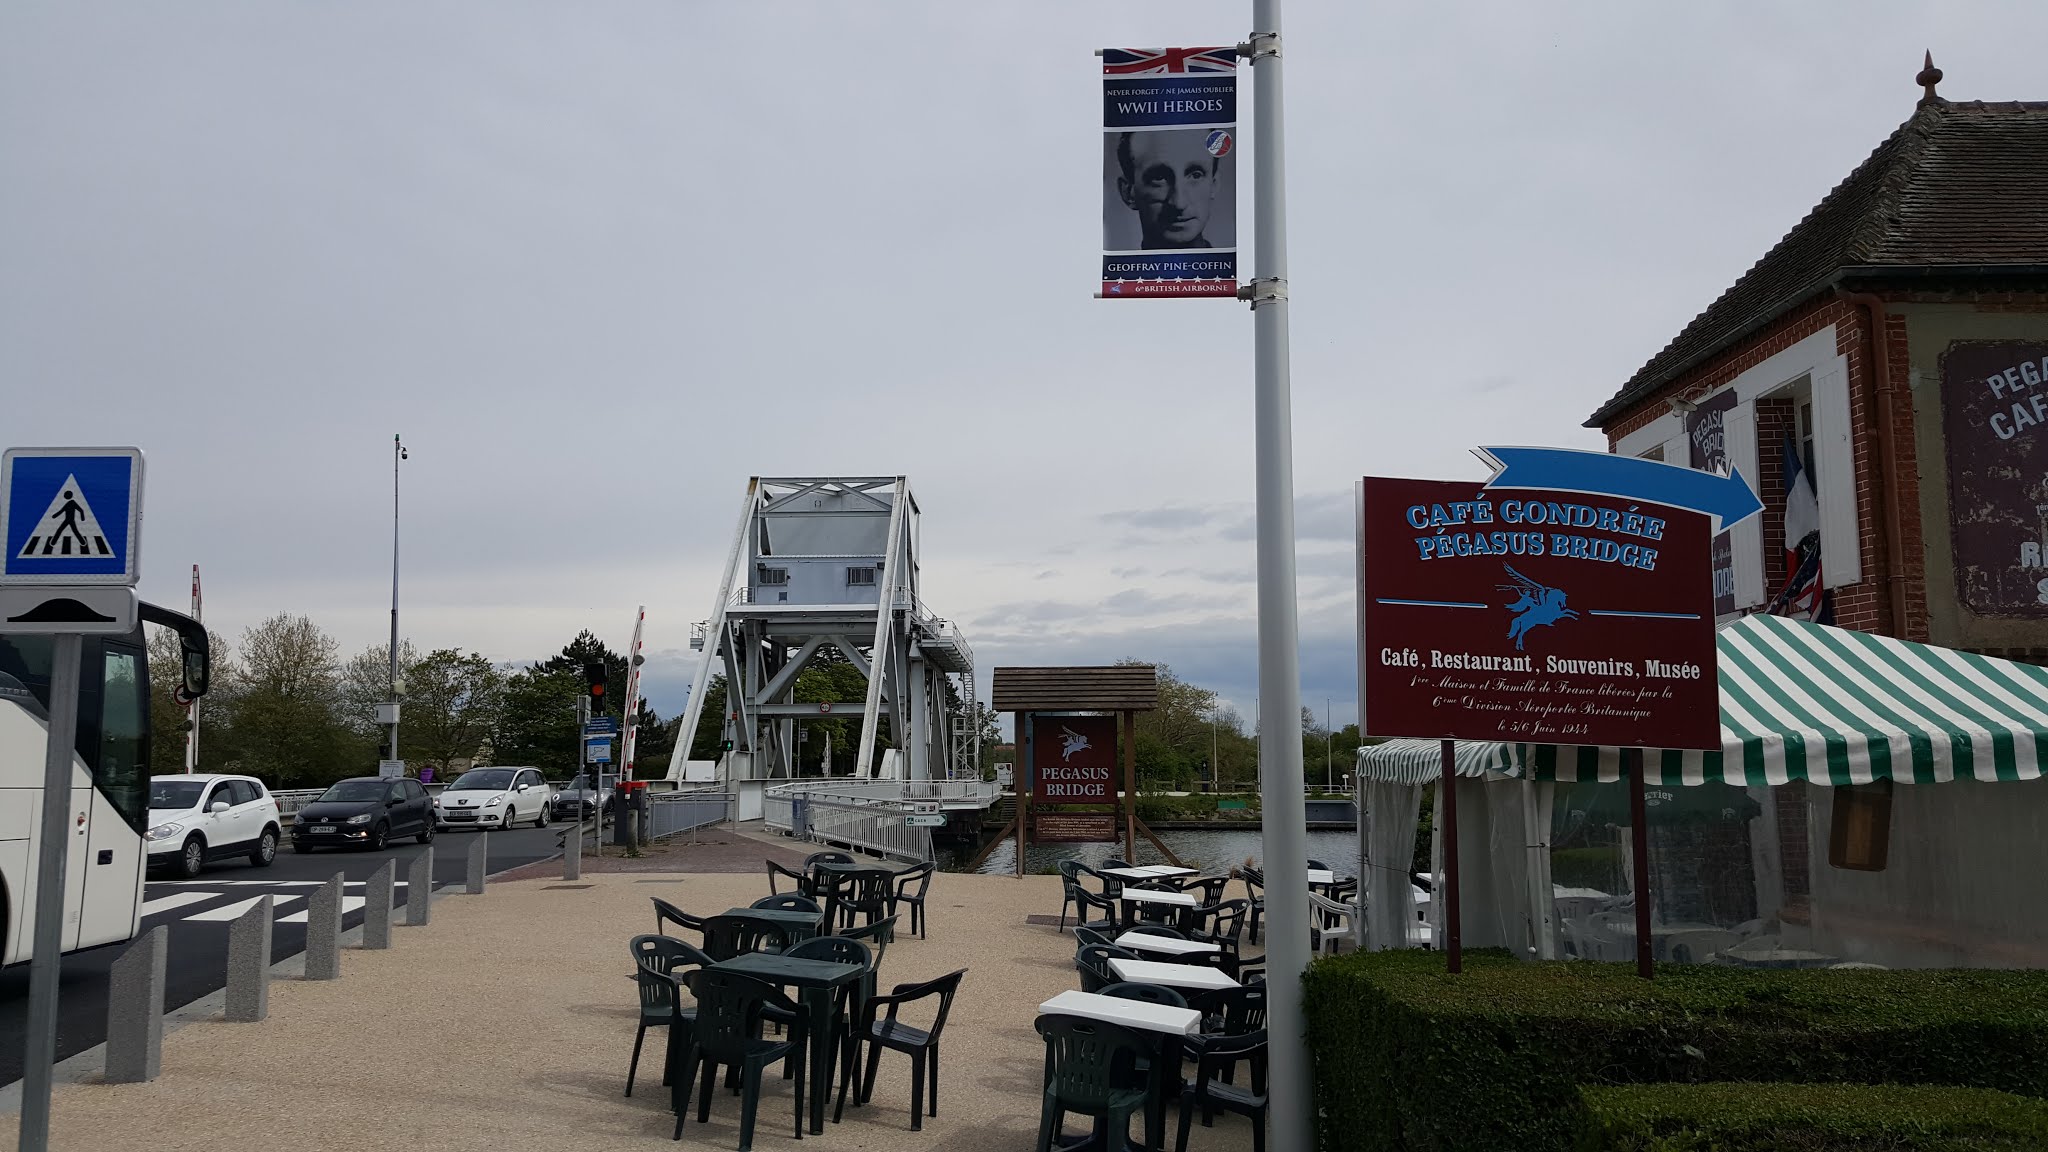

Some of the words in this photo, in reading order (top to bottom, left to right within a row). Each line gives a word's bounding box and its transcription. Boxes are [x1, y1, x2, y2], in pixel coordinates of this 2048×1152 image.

[1177, 87, 1202, 95] JAMAIS
[1203, 86, 1234, 94] OUBLIER
[1117, 101, 1158, 114] WWII
[1163, 99, 1223, 113] HEROES
[1108, 262, 1161, 272] GEOFFRAY
[1163, 261, 1232, 271] PINE-COFFIN
[1181, 284, 1228, 292] AIRBORNE
[1406, 493, 1494, 529] CAFÉ
[1499, 500, 1666, 540] GONDRÉE
[1415, 527, 1545, 561] PÉGASUS
[1550, 533, 1659, 571] BRIDGE
[1645, 659, 1701, 680] Musée
[1432, 674, 1477, 689] Maison
[1480, 679, 1490, 690] et
[1492, 677, 1536, 692] Famille
[1539, 680, 1551, 693] de
[1554, 680, 1595, 695] France
[1598, 682, 1636, 697] libérées
[1635, 686, 1658, 703] par
[1661, 685, 1673, 699] la
[1460, 695, 1511, 711] Division
[1515, 698, 1577, 718] Aéroportée
[1580, 700, 1652, 721] Britannique
[1497, 719, 1506, 731] le
[1510, 720, 1530, 733] 5/6
[1530, 719, 1556, 735] Juin
[1561, 723, 1589, 735] 1944
[1041, 767, 1109, 780] PEGASUS
[1046, 783, 1105, 796] BRIDGE
